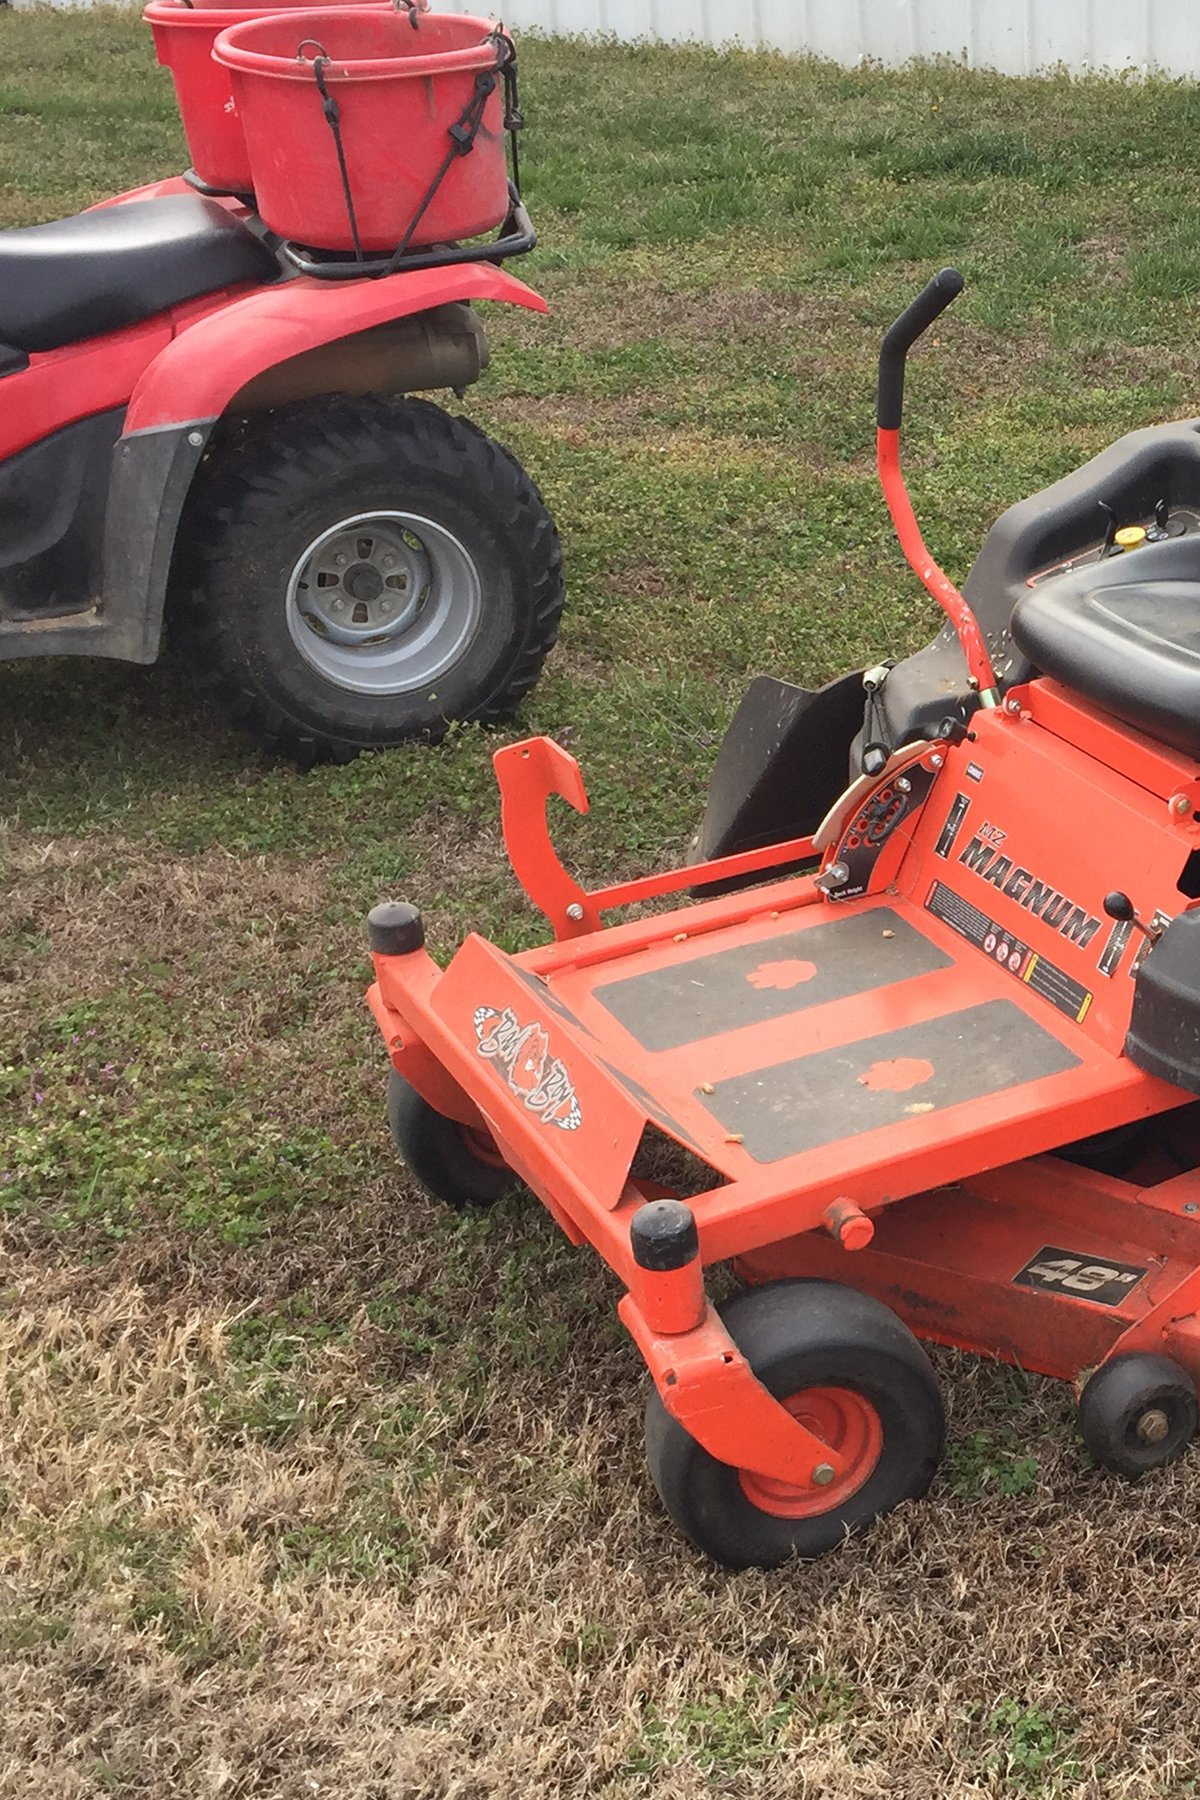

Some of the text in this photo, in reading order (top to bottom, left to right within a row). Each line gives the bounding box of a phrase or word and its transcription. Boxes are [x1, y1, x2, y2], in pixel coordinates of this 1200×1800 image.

[978, 821, 1007, 847] MZ
[958, 836, 1102, 950] MAGNUM
[1026, 1259, 1139, 1291] 48"
